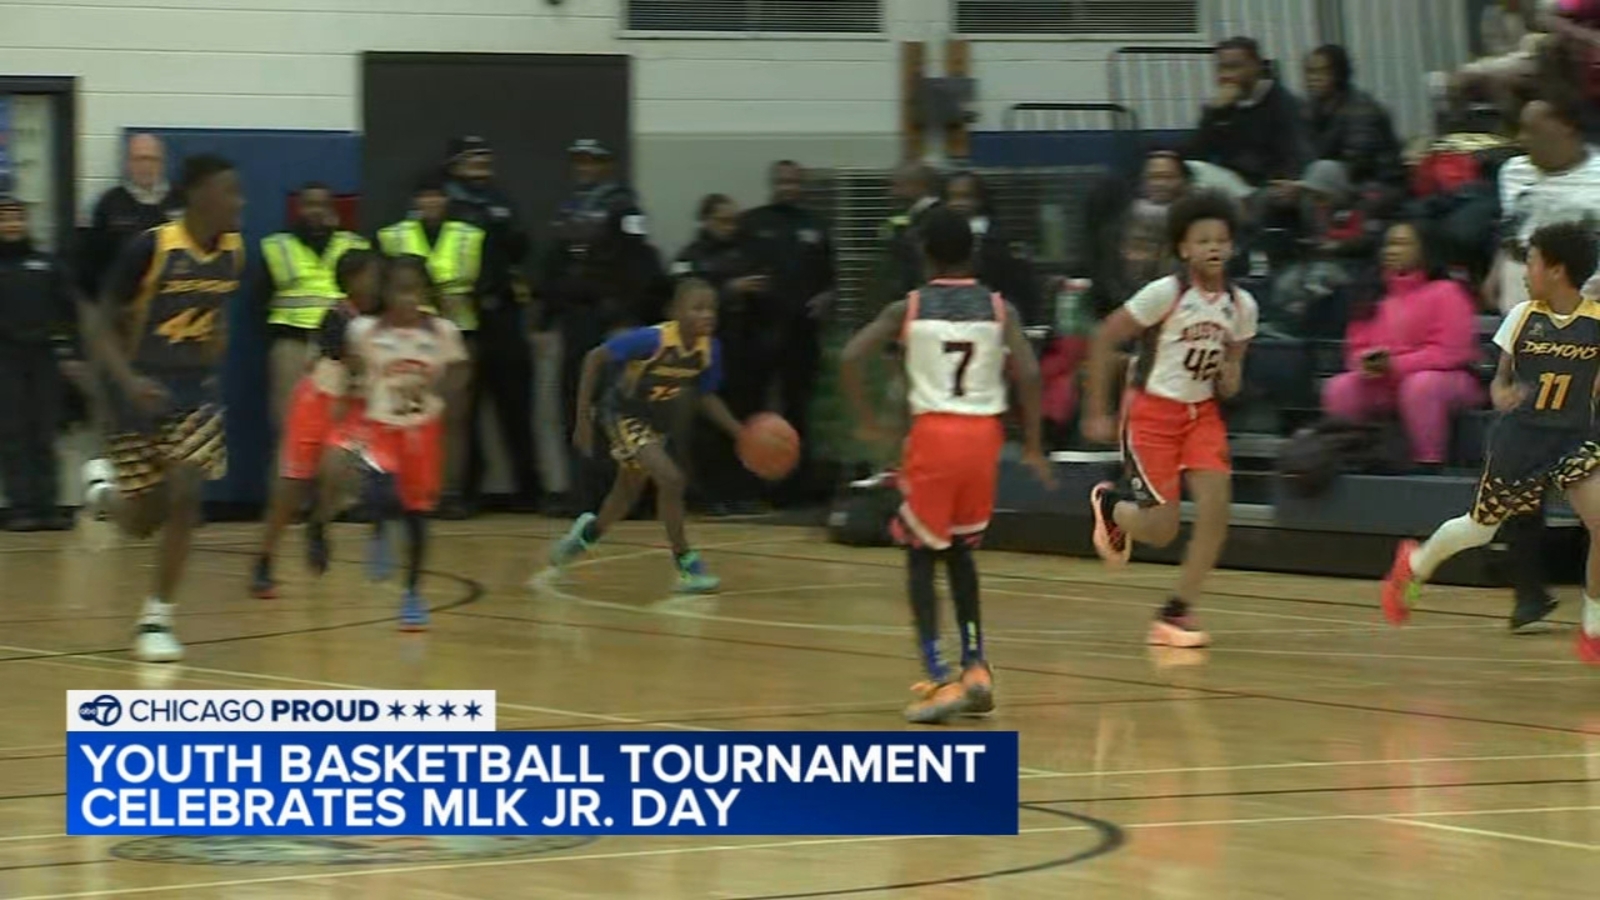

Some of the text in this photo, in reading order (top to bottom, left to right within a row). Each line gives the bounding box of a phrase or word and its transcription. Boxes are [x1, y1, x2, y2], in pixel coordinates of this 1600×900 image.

[943, 341, 974, 397] 7
[1521, 340, 1600, 360] DEMONS
[1535, 372, 1572, 411] 11
